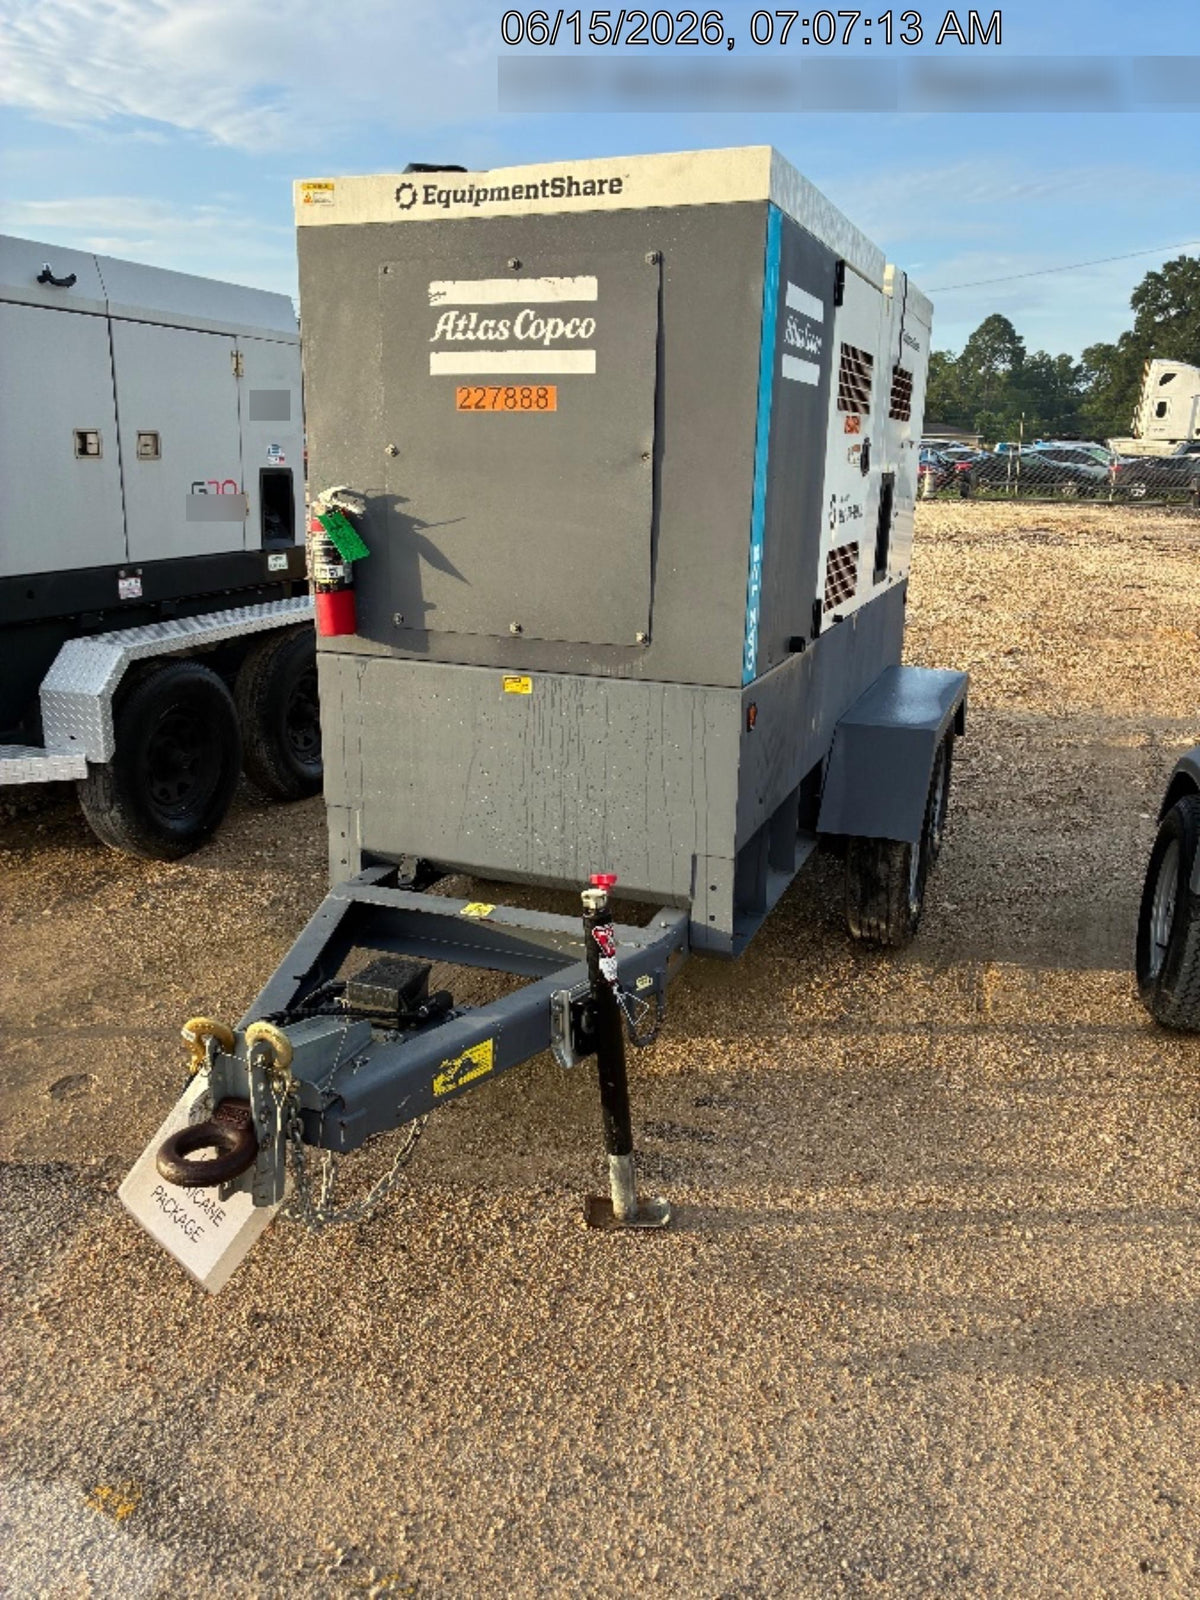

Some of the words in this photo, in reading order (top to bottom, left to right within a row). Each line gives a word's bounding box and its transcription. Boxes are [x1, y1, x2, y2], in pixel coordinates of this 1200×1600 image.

[422, 176, 623, 208] EquipmentShare
[428, 311, 510, 342] Atlas
[513, 308, 597, 345] Copco
[457, 386, 550, 410] 227888
[150, 1185, 206, 1243] PACKAGE
[182, 1186, 227, 1228] ICANE
